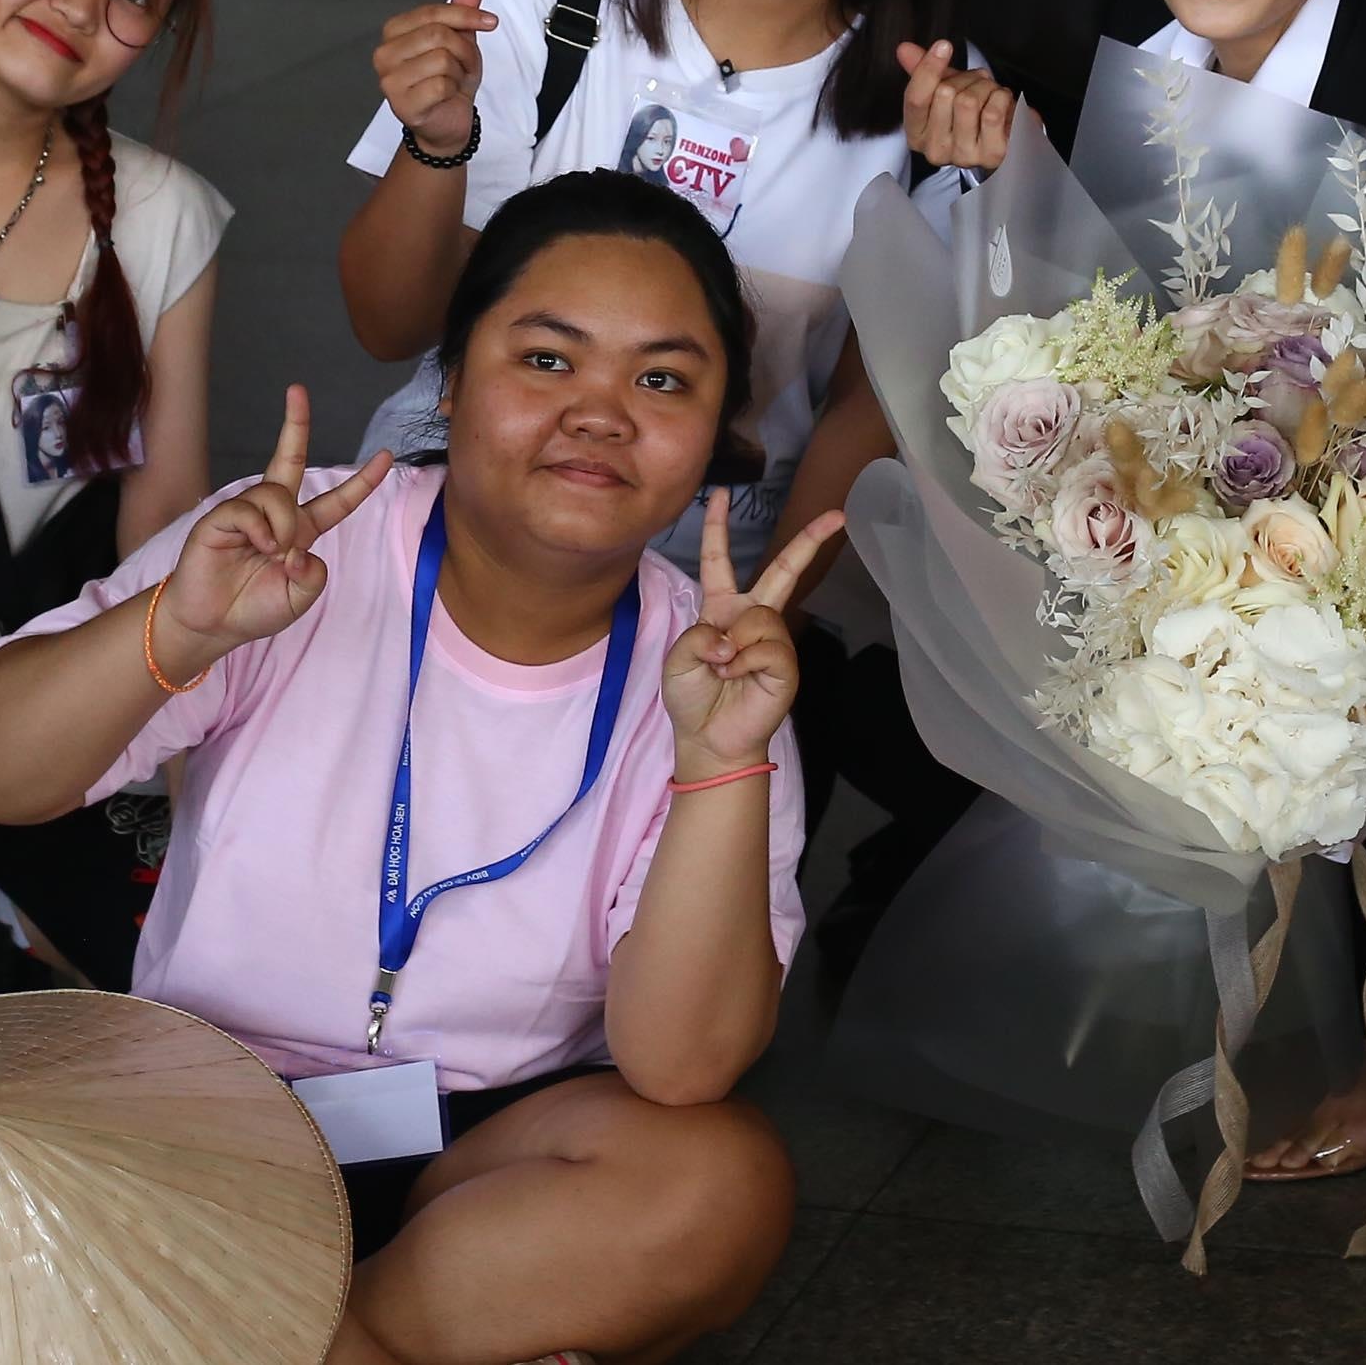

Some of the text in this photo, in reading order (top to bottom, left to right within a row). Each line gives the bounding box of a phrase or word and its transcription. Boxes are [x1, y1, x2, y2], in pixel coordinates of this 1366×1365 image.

[679, 138, 735, 167] FERNZONE
[666, 154, 737, 198] CTV
[394, 803, 406, 823] SEN
[390, 822, 403, 846] HOA
[466, 870, 489, 882] BIDV
